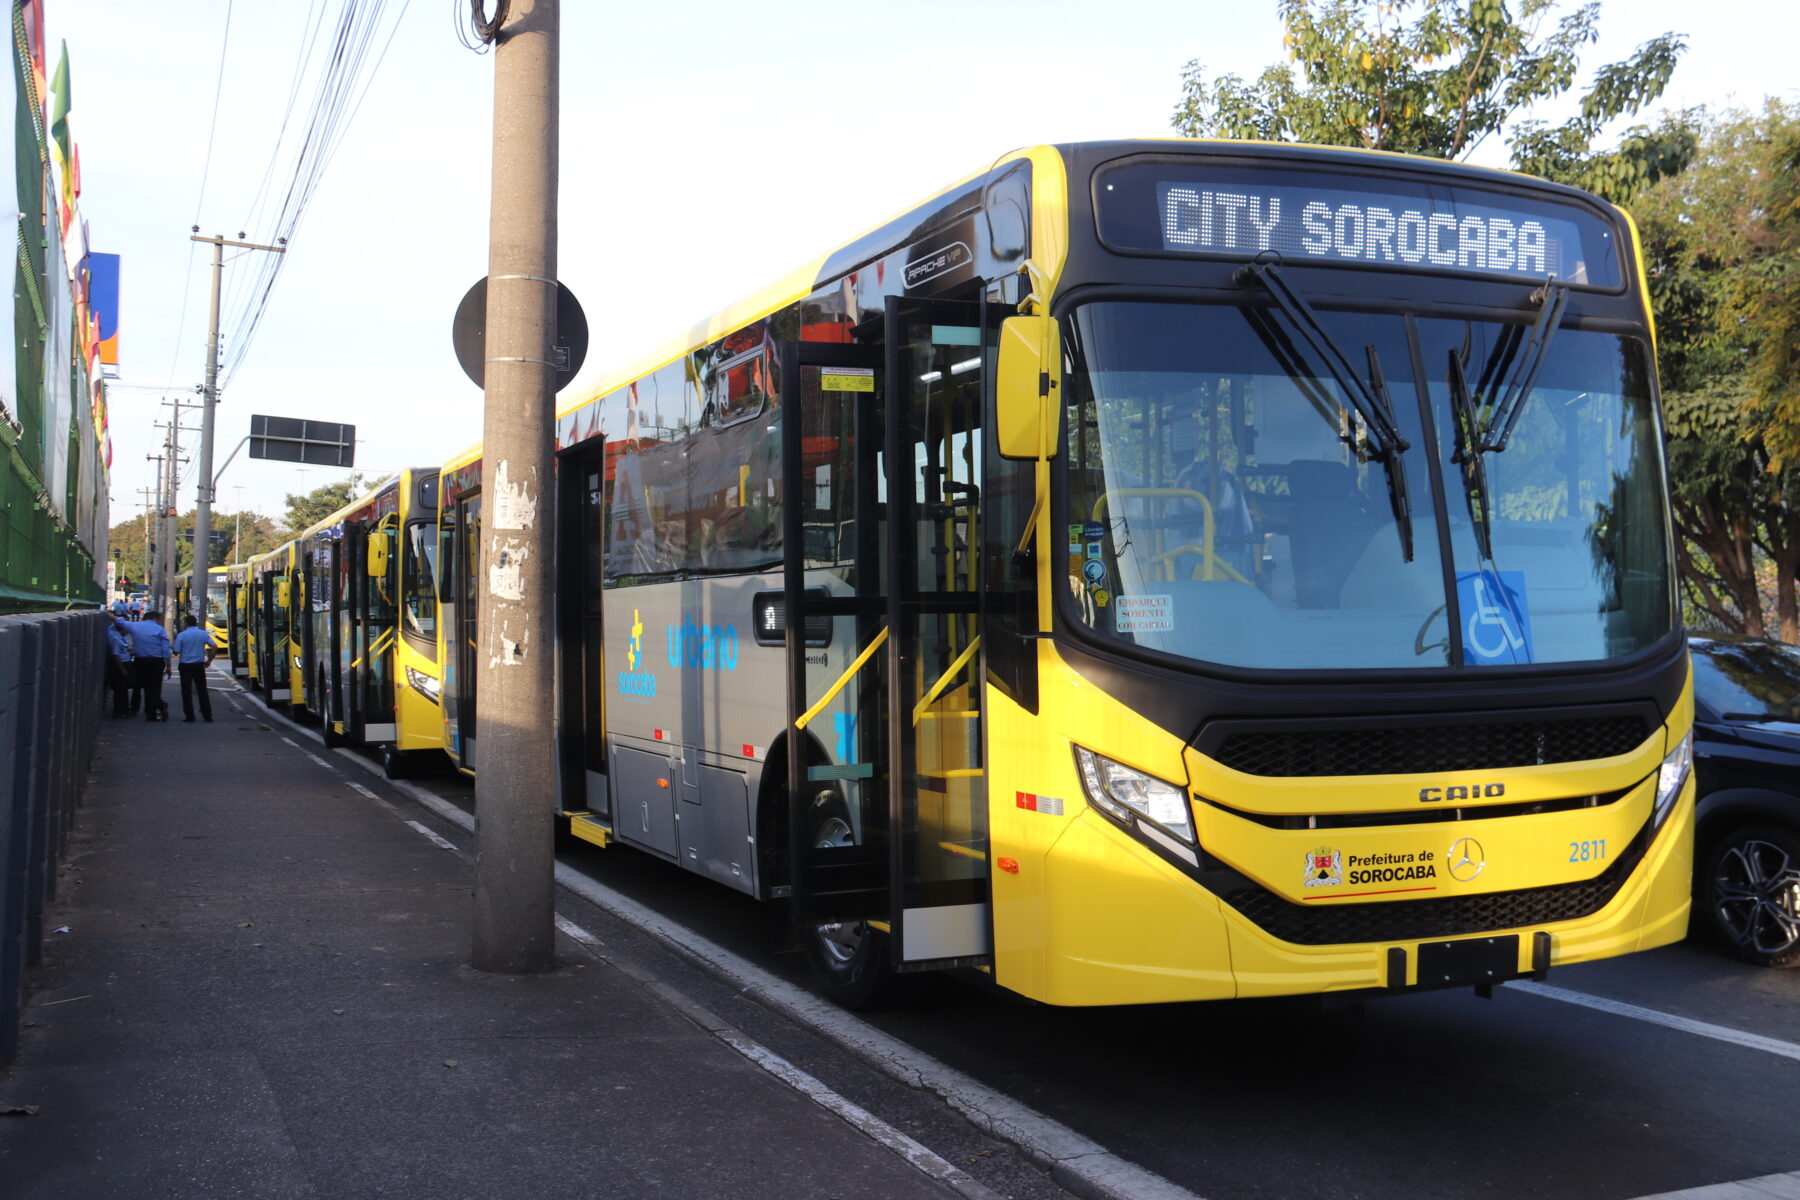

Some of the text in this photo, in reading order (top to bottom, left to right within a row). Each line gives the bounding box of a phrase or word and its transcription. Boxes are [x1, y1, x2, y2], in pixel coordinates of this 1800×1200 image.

[1166, 188, 1546, 273] CITY SOROCABA
[667, 613, 738, 672] urbano
[618, 669, 657, 698] sorocaba
[1419, 783, 1505, 802] CAIO
[1348, 850, 1434, 867] Prefeitura de
[1568, 839, 1606, 862] 2811
[1349, 866, 1436, 885] SOROCABA
